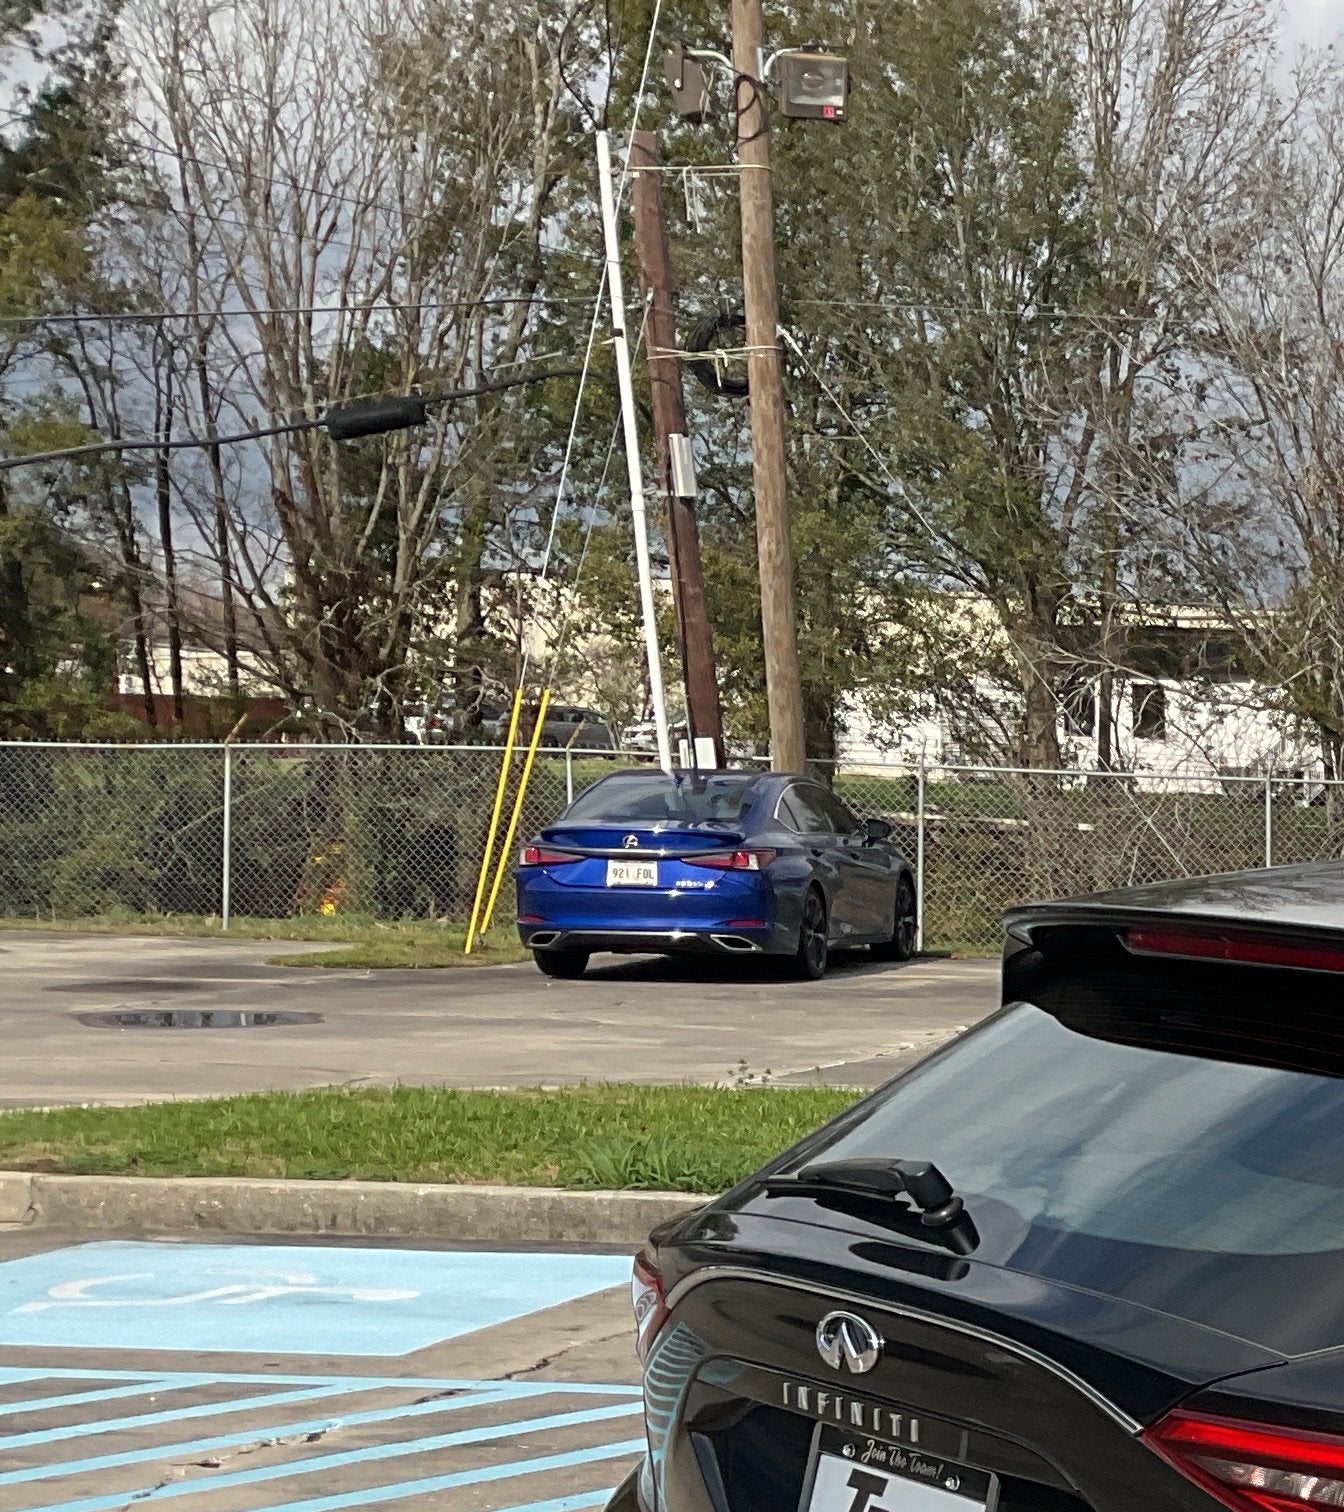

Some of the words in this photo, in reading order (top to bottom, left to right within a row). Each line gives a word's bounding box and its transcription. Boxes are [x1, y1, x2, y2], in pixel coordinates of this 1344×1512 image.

[612, 868, 629, 879] 921
[783, 1382, 919, 1442] INFINITI
[860, 1439, 887, 1464] Join
[888, 1446, 908, 1468] The
